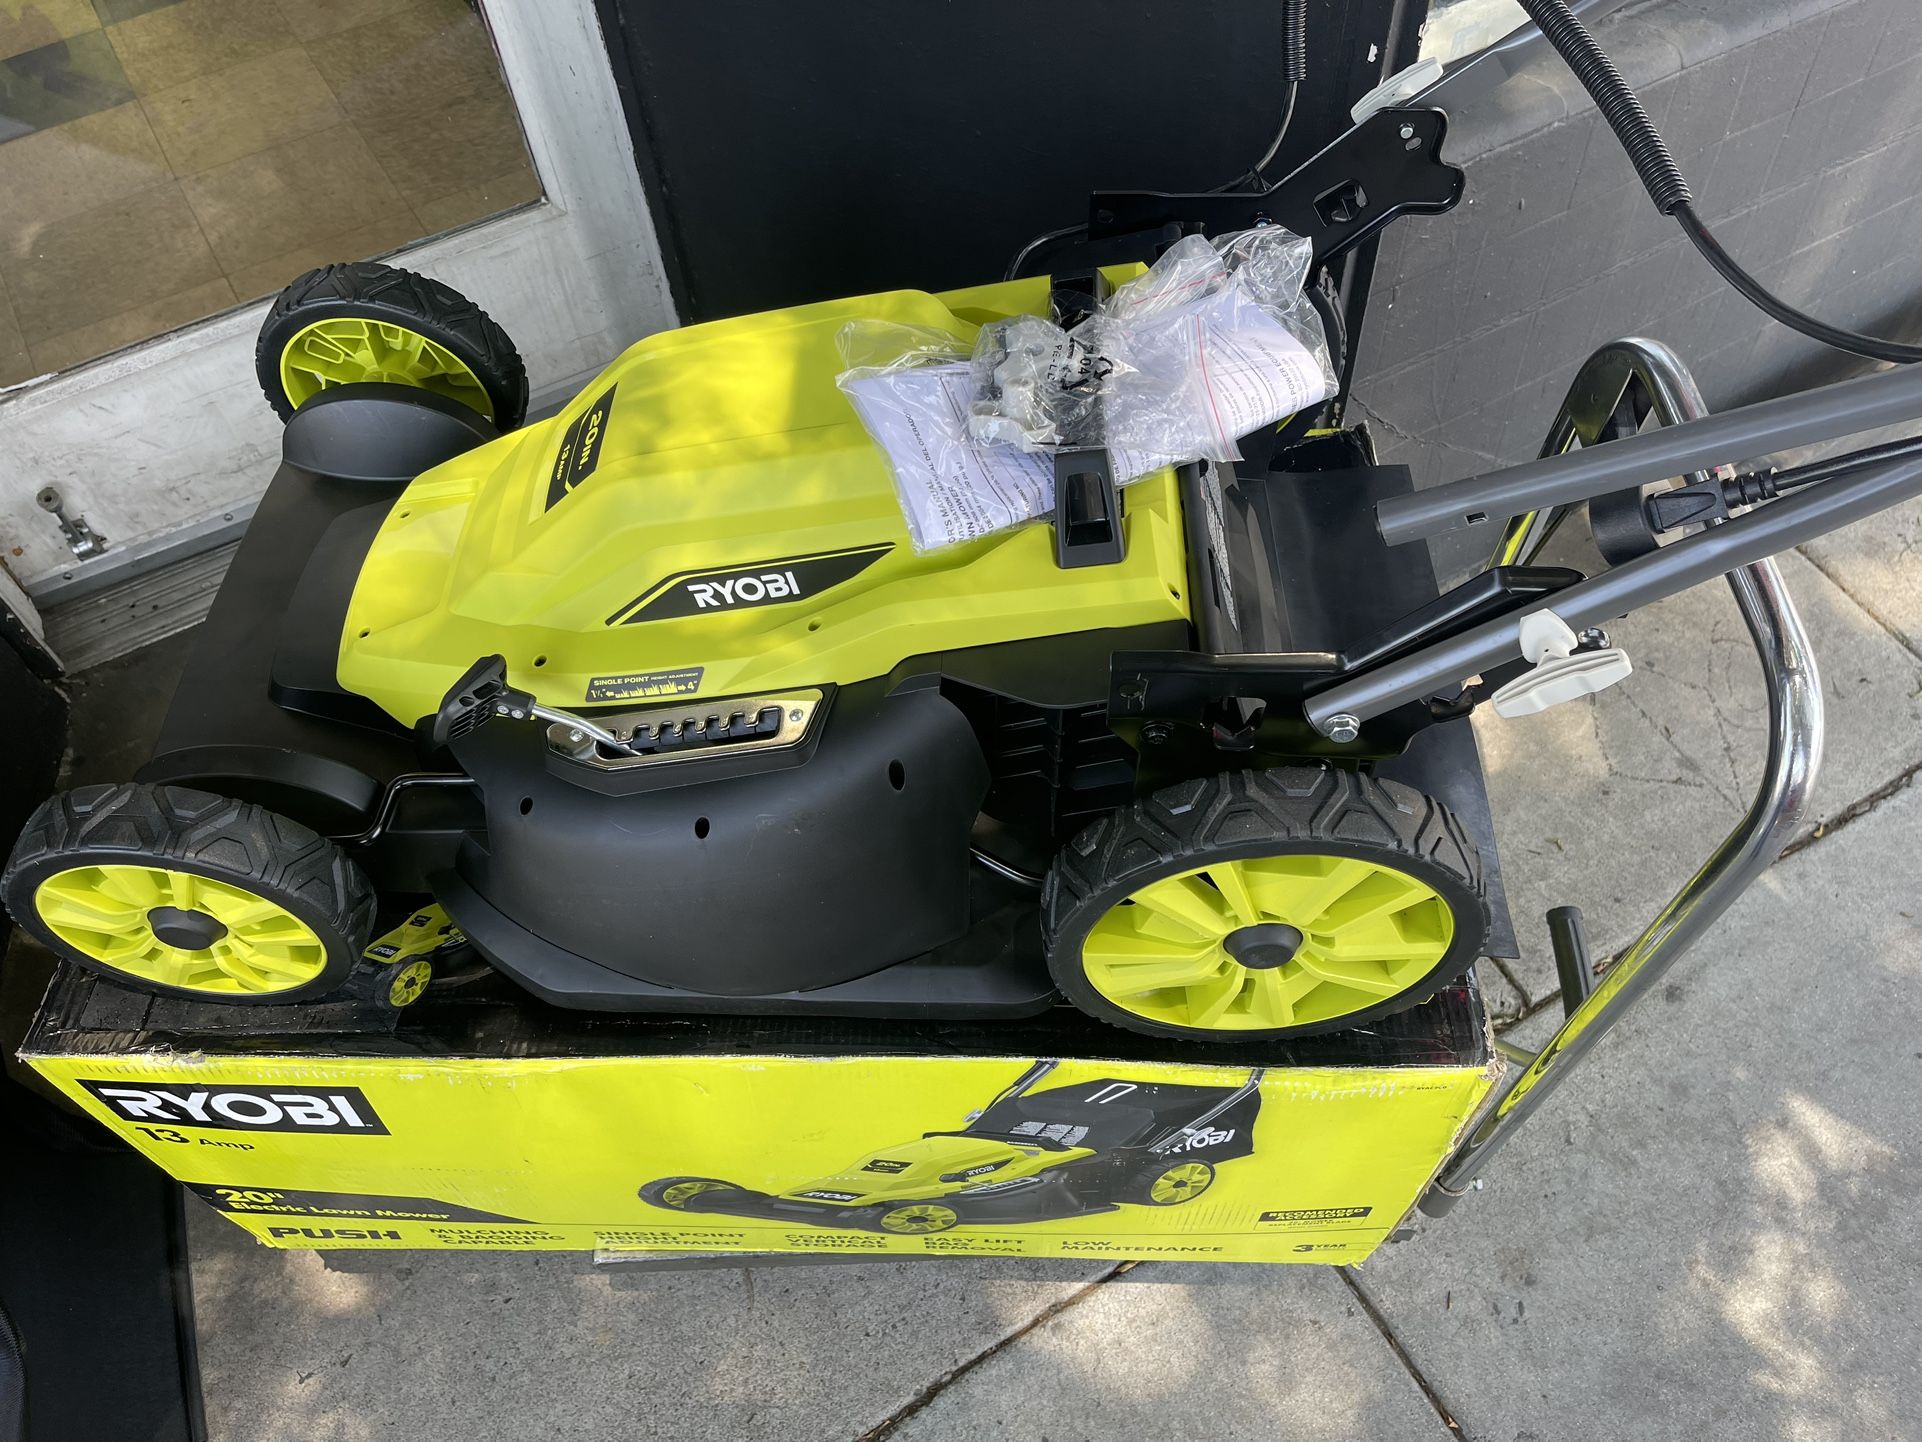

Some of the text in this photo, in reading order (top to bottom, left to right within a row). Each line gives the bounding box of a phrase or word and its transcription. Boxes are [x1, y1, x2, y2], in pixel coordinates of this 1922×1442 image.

[1078, 358, 1092, 374] 04
[1280, 366, 1296, 396] POWER
[578, 410, 602, 470] 20IN.
[562, 444, 570, 460] 13
[926, 480, 949, 518] MANUAL
[687, 572, 800, 608] RYOBI
[98, 1088, 366, 1127] RYOBI
[135, 1127, 255, 1150] 13 Amp
[966, 1164, 995, 1176] RYOBI
[216, 1188, 284, 1204] 20"
[804, 1192, 856, 1200] RYOBI
[229, 1202, 450, 1220] Electric Lawn Mower
[1269, 1208, 1364, 1217] RECOMENDED
[267, 1227, 402, 1240] PUSH
[430, 1228, 550, 1236] MULCHING
[1292, 1244, 1314, 1252] 3
